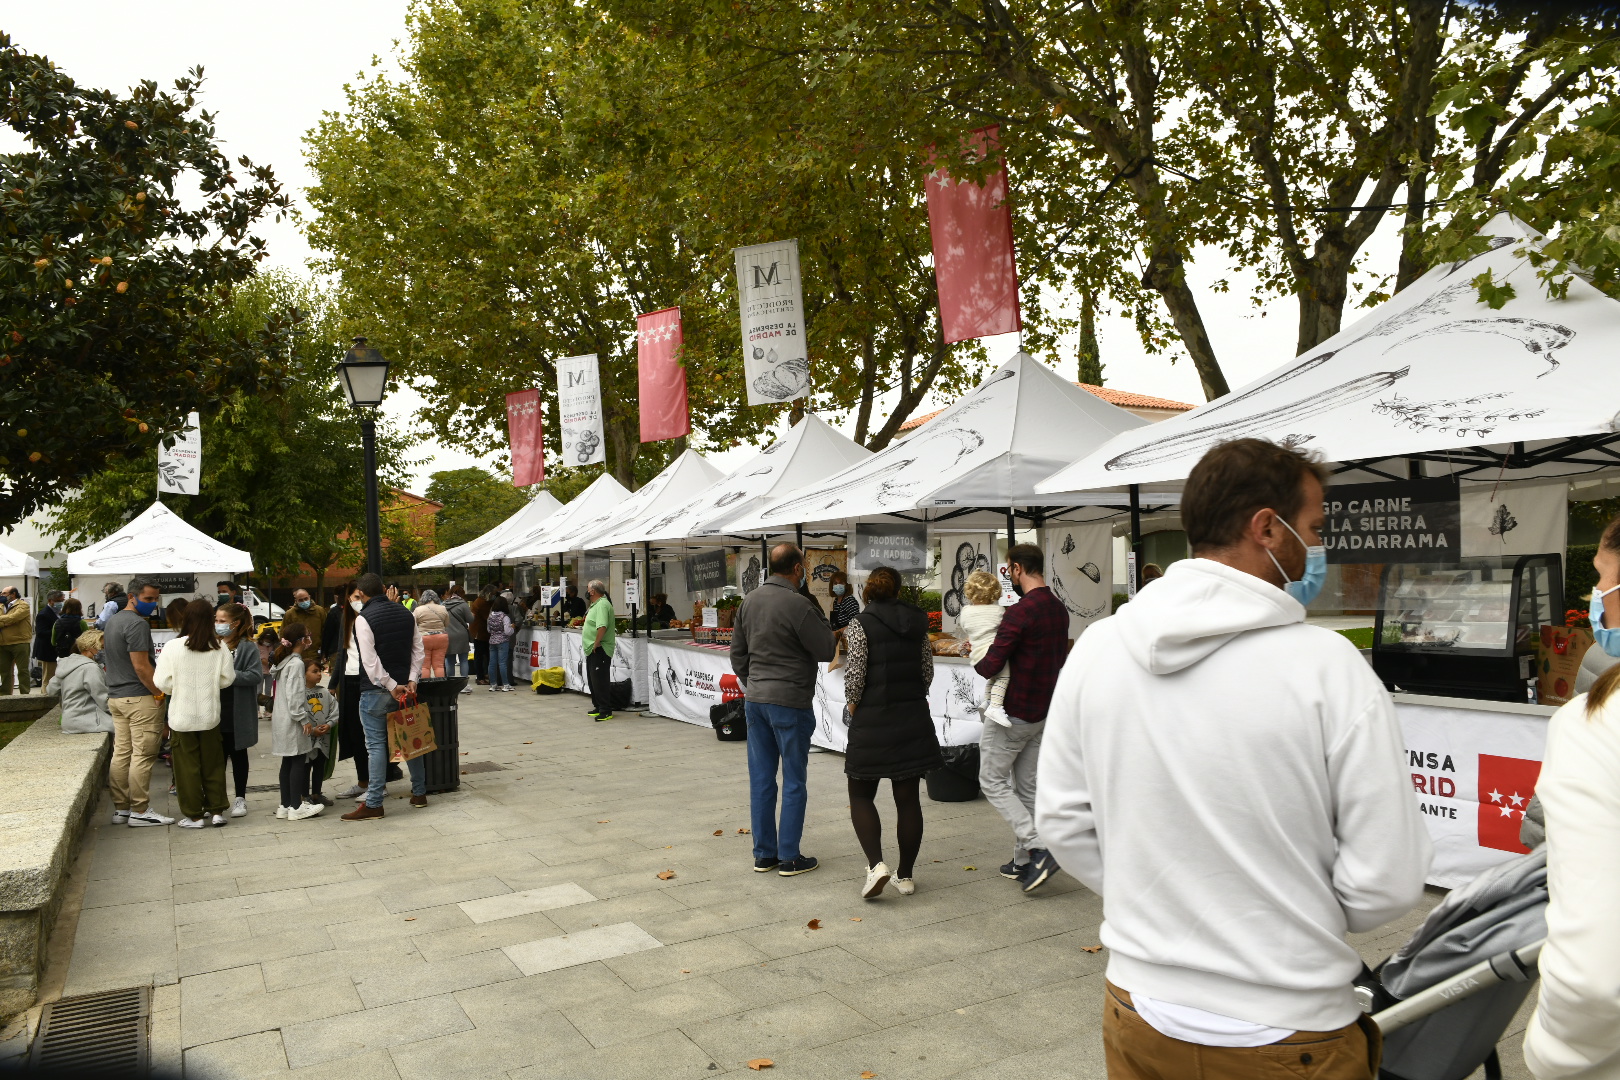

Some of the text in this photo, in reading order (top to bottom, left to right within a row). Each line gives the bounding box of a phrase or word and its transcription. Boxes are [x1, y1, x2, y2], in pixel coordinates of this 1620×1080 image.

[1347, 496, 1412, 514] CARNE
[1330, 514, 1427, 533] LA SIERRA
[868, 535, 915, 546] PRODUCTOS
[1320, 532, 1449, 550] UADARRAMA
[870, 548, 913, 560] DE MADRID
[702, 570, 720, 580] MADRID
[684, 677, 694, 688] DE
[1404, 749, 1456, 773] NSA
[1439, 976, 1480, 1000] VISTA
